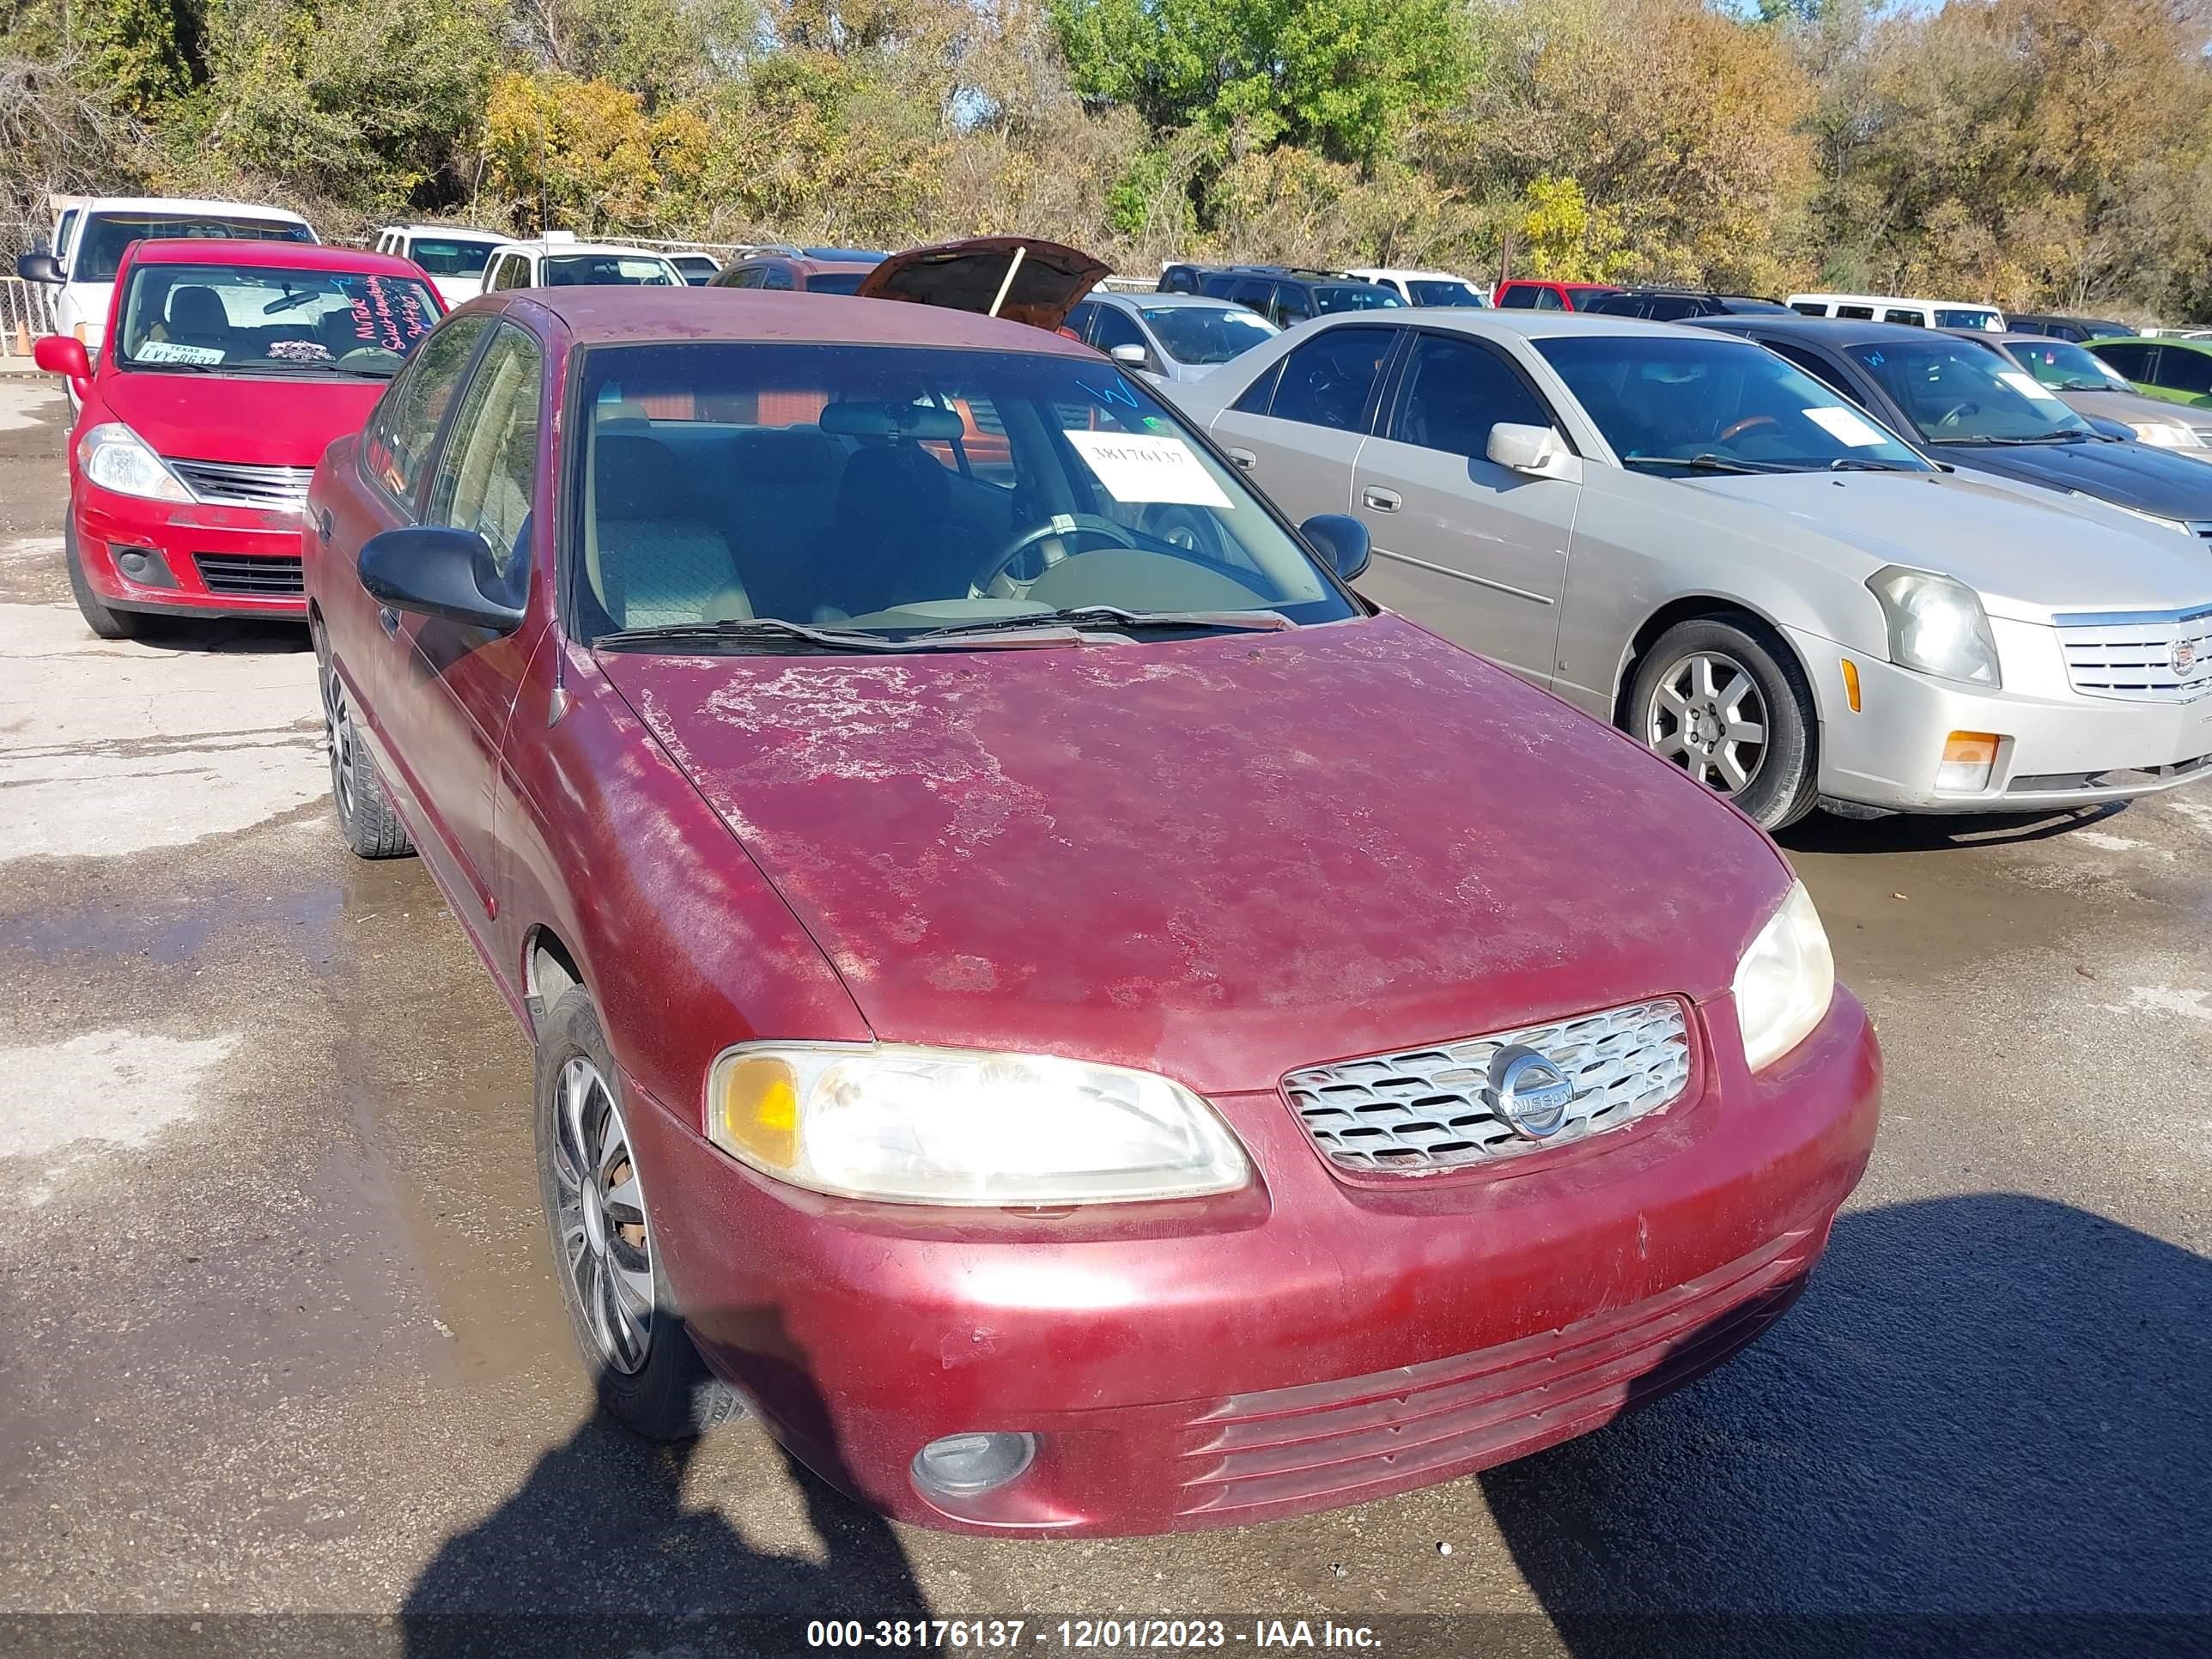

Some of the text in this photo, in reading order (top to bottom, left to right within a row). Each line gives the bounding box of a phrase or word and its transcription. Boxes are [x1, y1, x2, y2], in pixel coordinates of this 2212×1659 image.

[1863, 350, 1885, 366] W
[1075, 378, 1139, 409] W
[1091, 447, 1185, 464] 38176137
[1514, 1090, 1572, 1116] NISSAN
